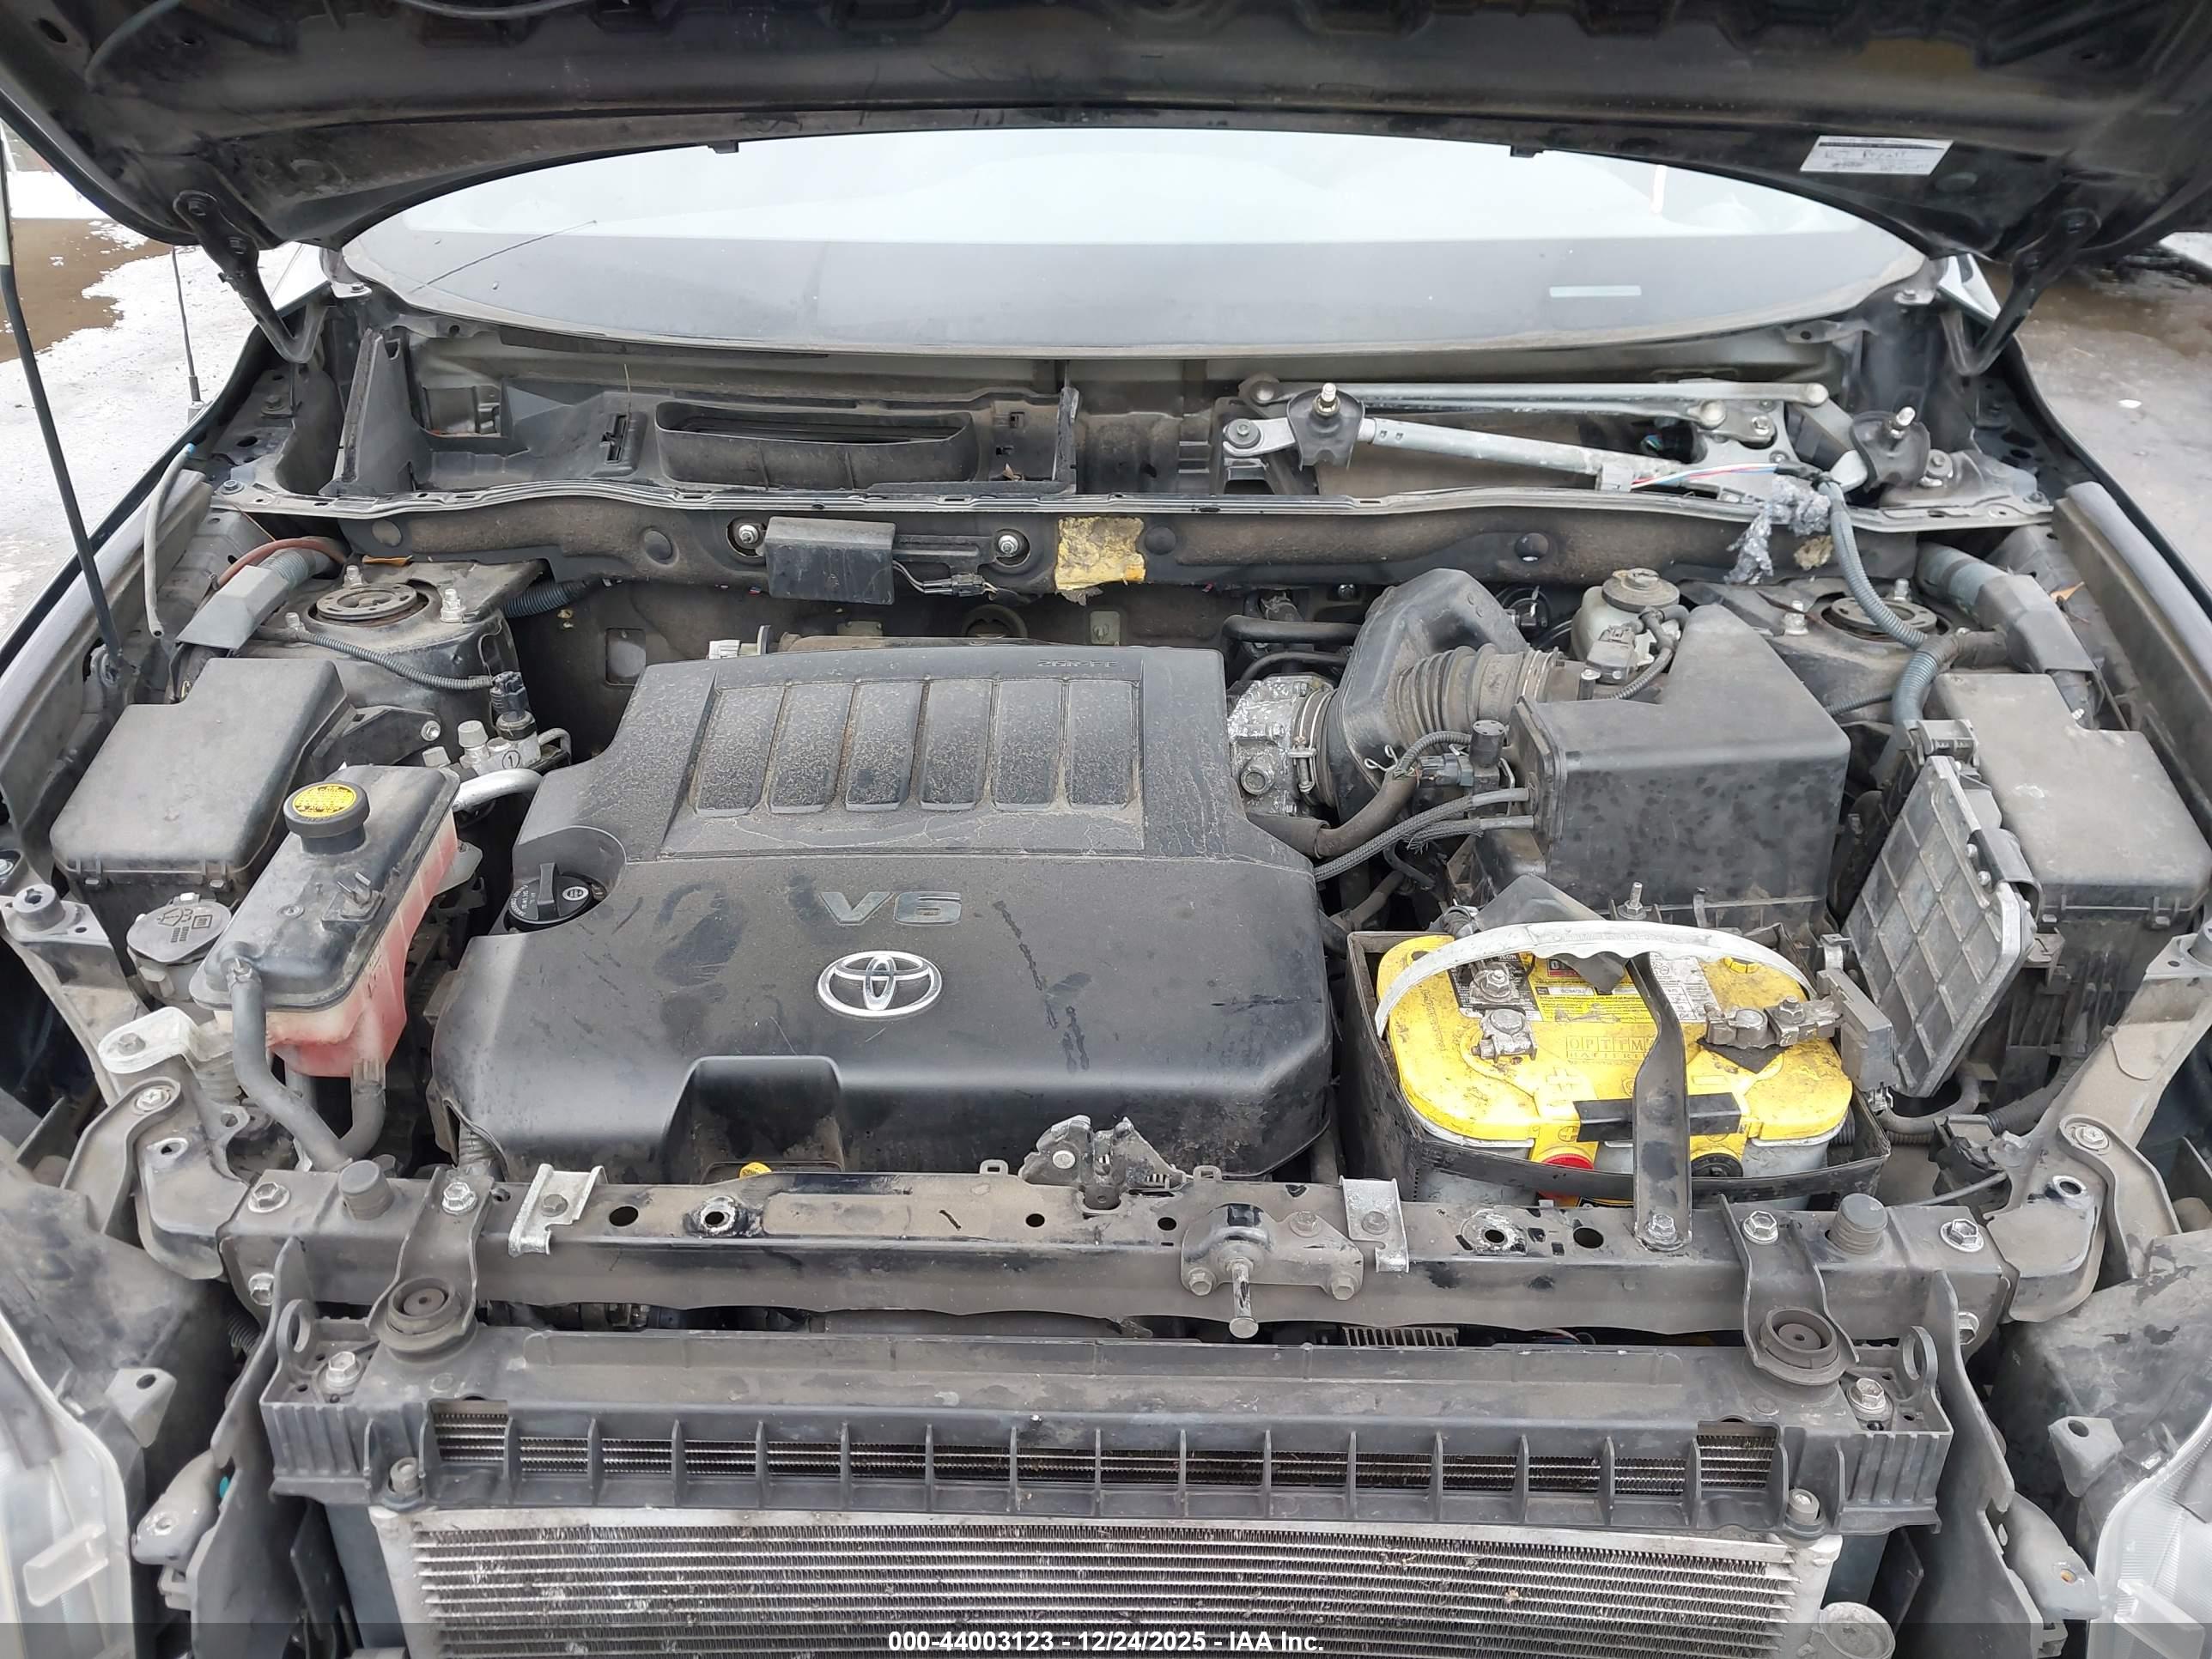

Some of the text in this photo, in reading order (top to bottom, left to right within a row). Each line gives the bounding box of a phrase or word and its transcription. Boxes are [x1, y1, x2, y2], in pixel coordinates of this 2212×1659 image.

[1036, 659, 1118, 667] 2GR-FE
[818, 890, 962, 927] V6
[1568, 1038, 1652, 1051] OPTIM
